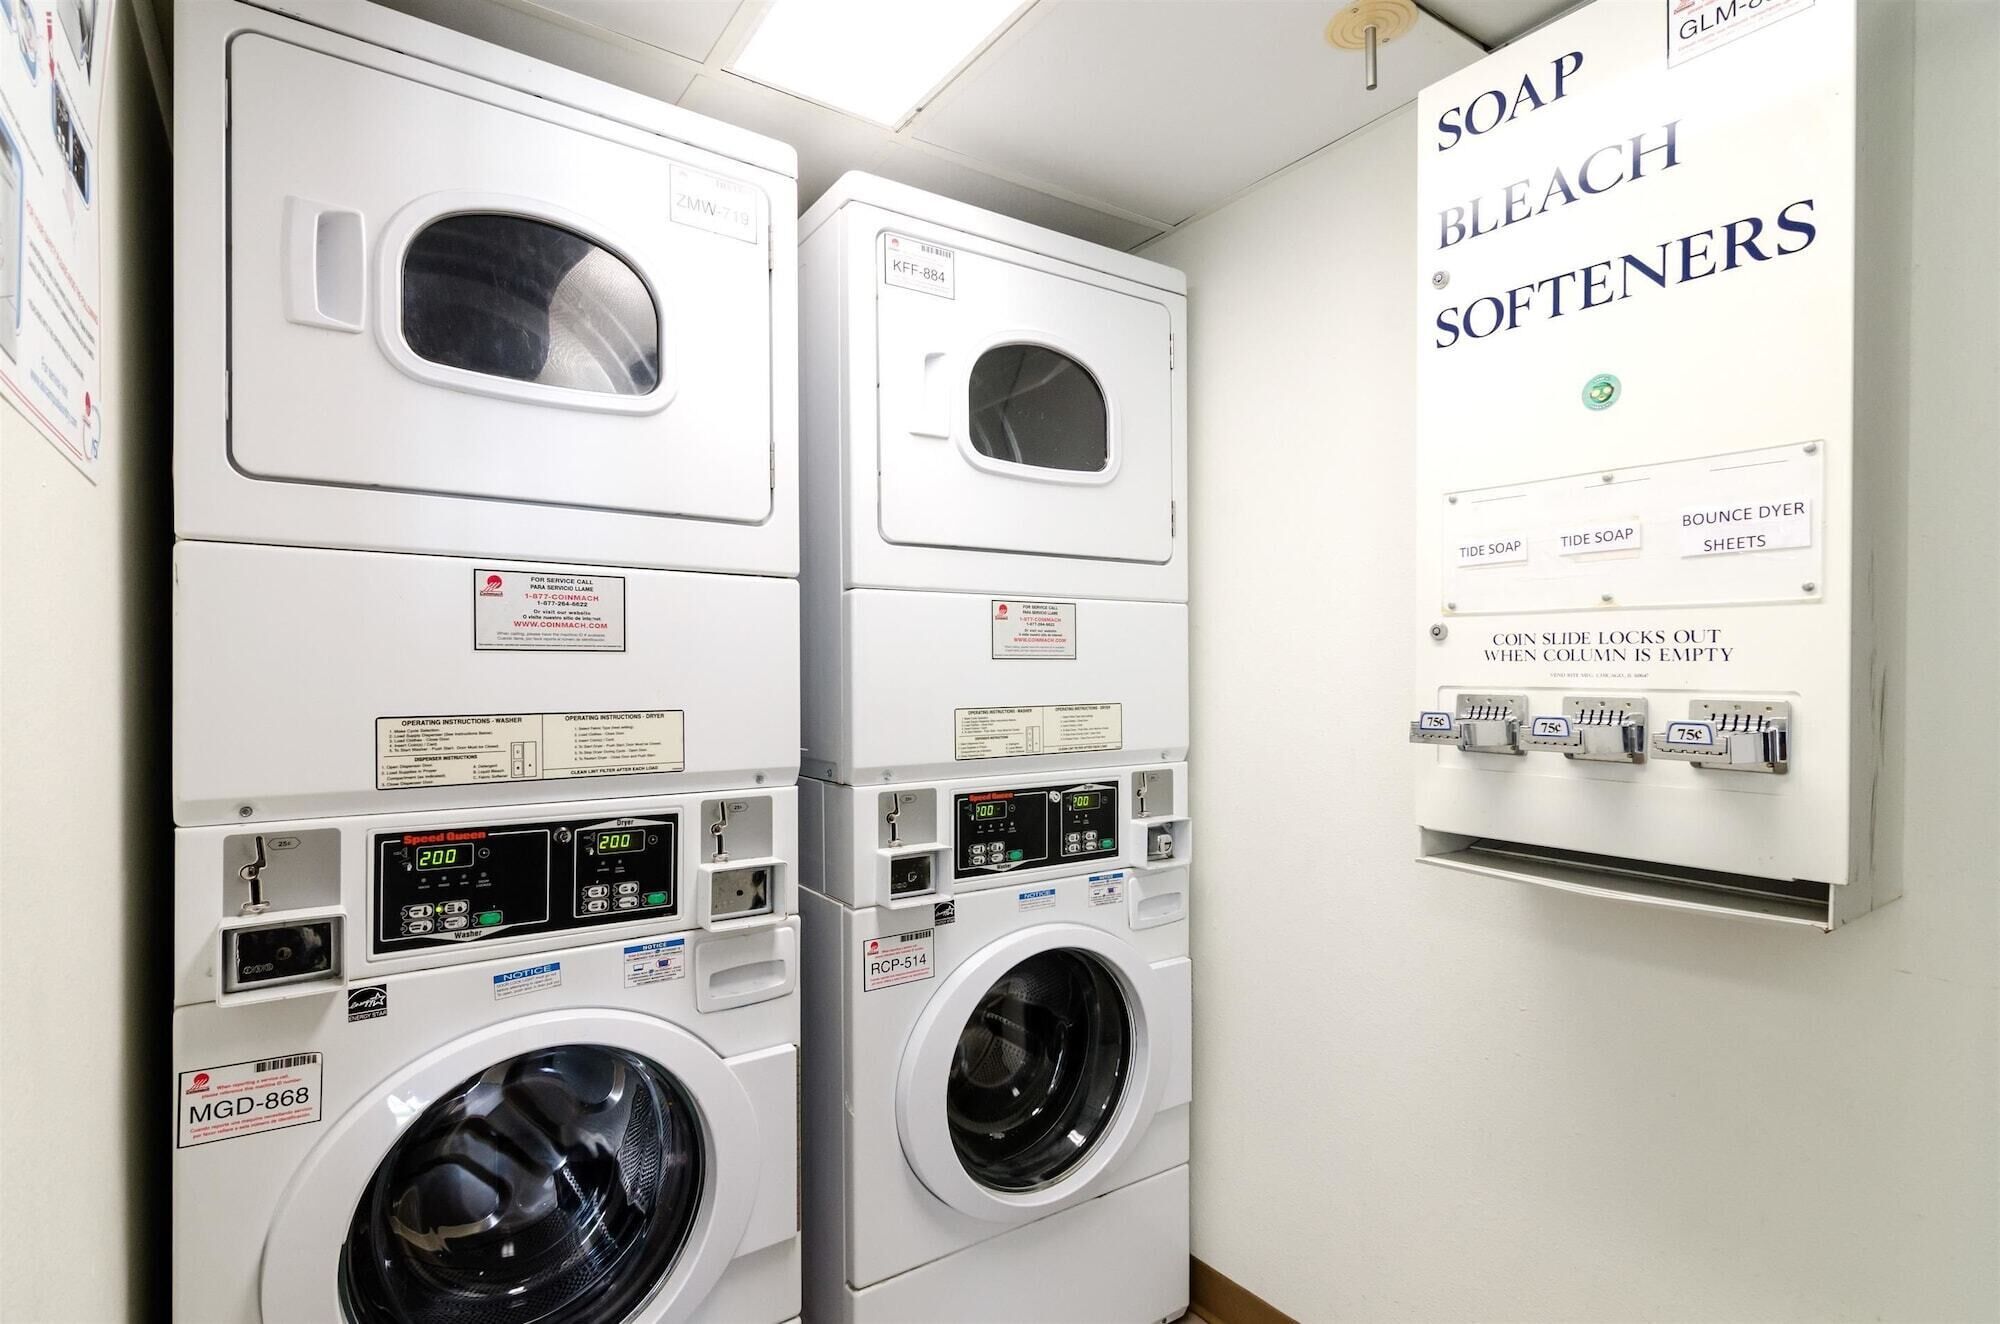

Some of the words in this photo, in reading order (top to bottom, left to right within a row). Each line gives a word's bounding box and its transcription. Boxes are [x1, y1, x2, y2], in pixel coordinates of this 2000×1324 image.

[1680, 0, 1771, 39] GLM-
[1438, 51, 1583, 152] SOAP
[1437, 119, 1681, 250] BLEACH
[676, 193, 749, 225] ZMW-719
[893, 259, 945, 283] KFF-884
[1436, 199, 1817, 349] SOFTENERS
[1683, 507, 1753, 527] BOUNCE
[1759, 502, 1805, 519] DYER
[1560, 534, 1590, 547] TIDE
[1595, 528, 1634, 543] SOAP
[1704, 534, 1767, 552] SHEETS
[1460, 545, 1484, 558] TIDE
[1489, 541, 1522, 555] SOAP
[525, 594, 599, 602] 1-877-COINMACH
[514, 620, 608, 629] WWW.COINMACH.COM
[1493, 633, 1537, 646] COIN
[1542, 632, 1591, 645] SLIDE
[1598, 630, 1666, 645] LOCKS
[1673, 629, 1721, 644] OUT
[1484, 649, 1536, 662] WHEN
[1543, 648, 1626, 662] COLUMN
[1635, 648, 1651, 662] IS
[1659, 647, 1734, 662] EMPTY
[1427, 717, 1445, 726] 75¢
[1541, 722, 1561, 733] 75¢
[1678, 729, 1702, 740] 75¢
[403, 833, 445, 845] Speed
[447, 831, 486, 841] Queen
[600, 834, 630, 849] 200
[420, 849, 457, 866] 200
[1024, 890, 1051, 899] NOTICE
[454, 930, 483, 939] Washer
[642, 942, 667, 951] NOTICE
[871, 953, 927, 975] RCP-514
[503, 965, 551, 981] NOTICE
[190, 1087, 309, 1124] MGD-868
